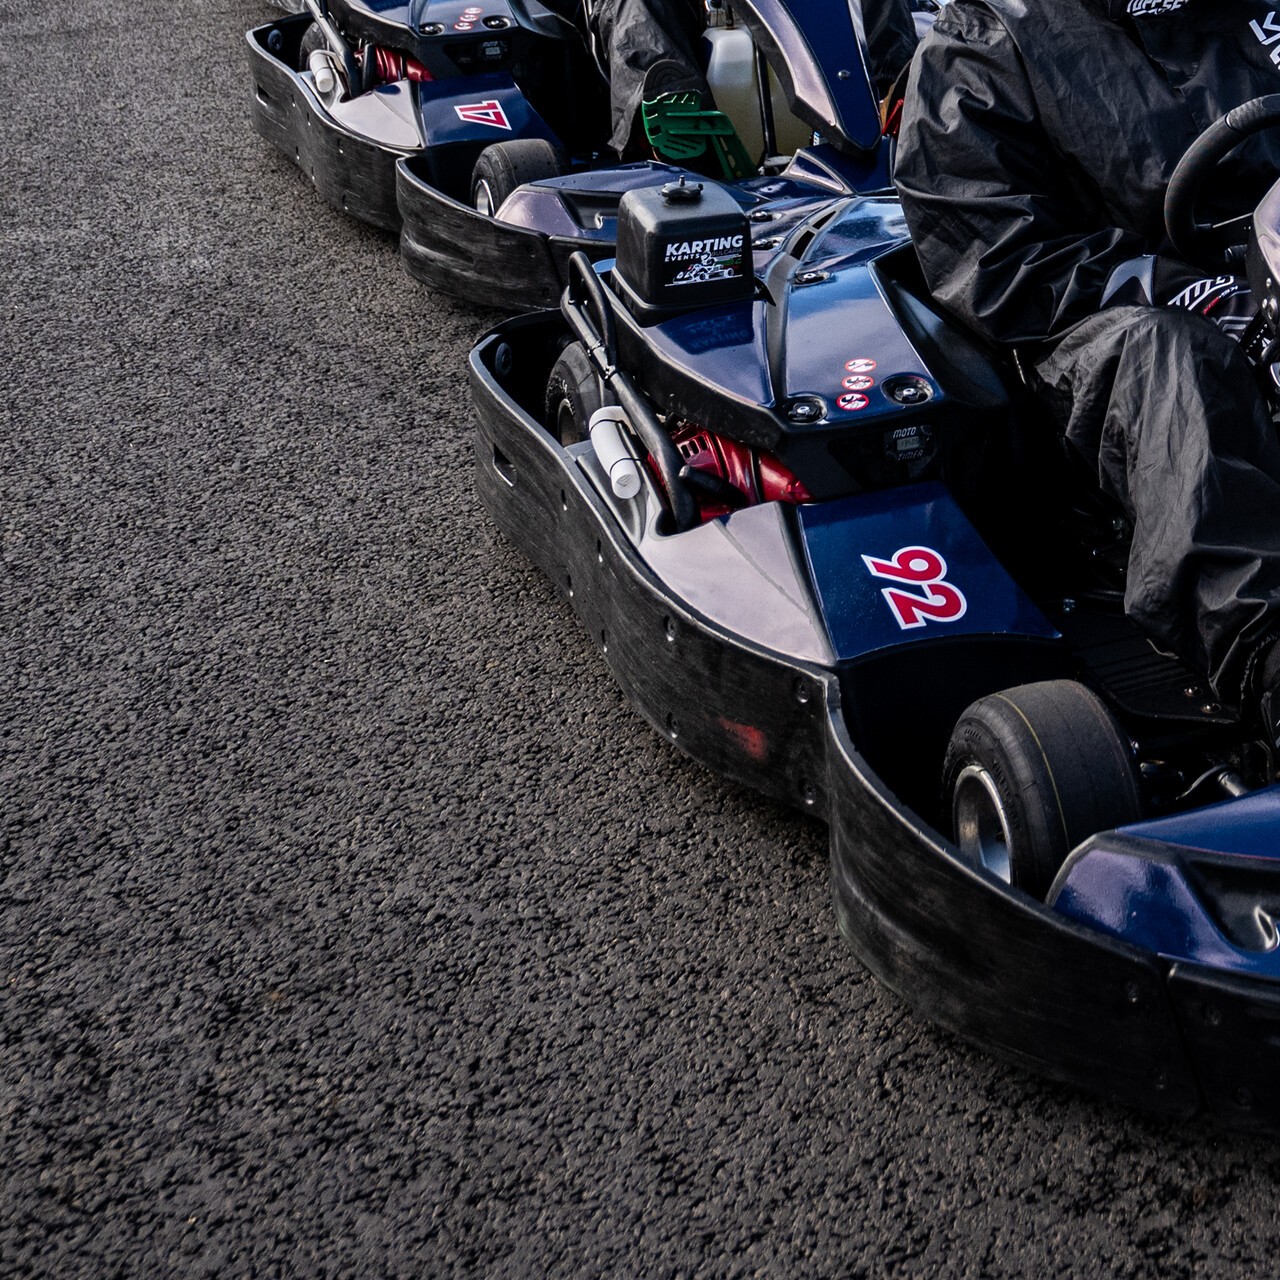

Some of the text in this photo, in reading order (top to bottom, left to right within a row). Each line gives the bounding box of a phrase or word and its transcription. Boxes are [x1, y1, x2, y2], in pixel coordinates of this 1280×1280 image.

[666, 235, 744, 256] KARTING
[664, 253, 700, 262] EVENTS
[893, 426, 917, 439] MOTO
[861, 545, 968, 630] 92
